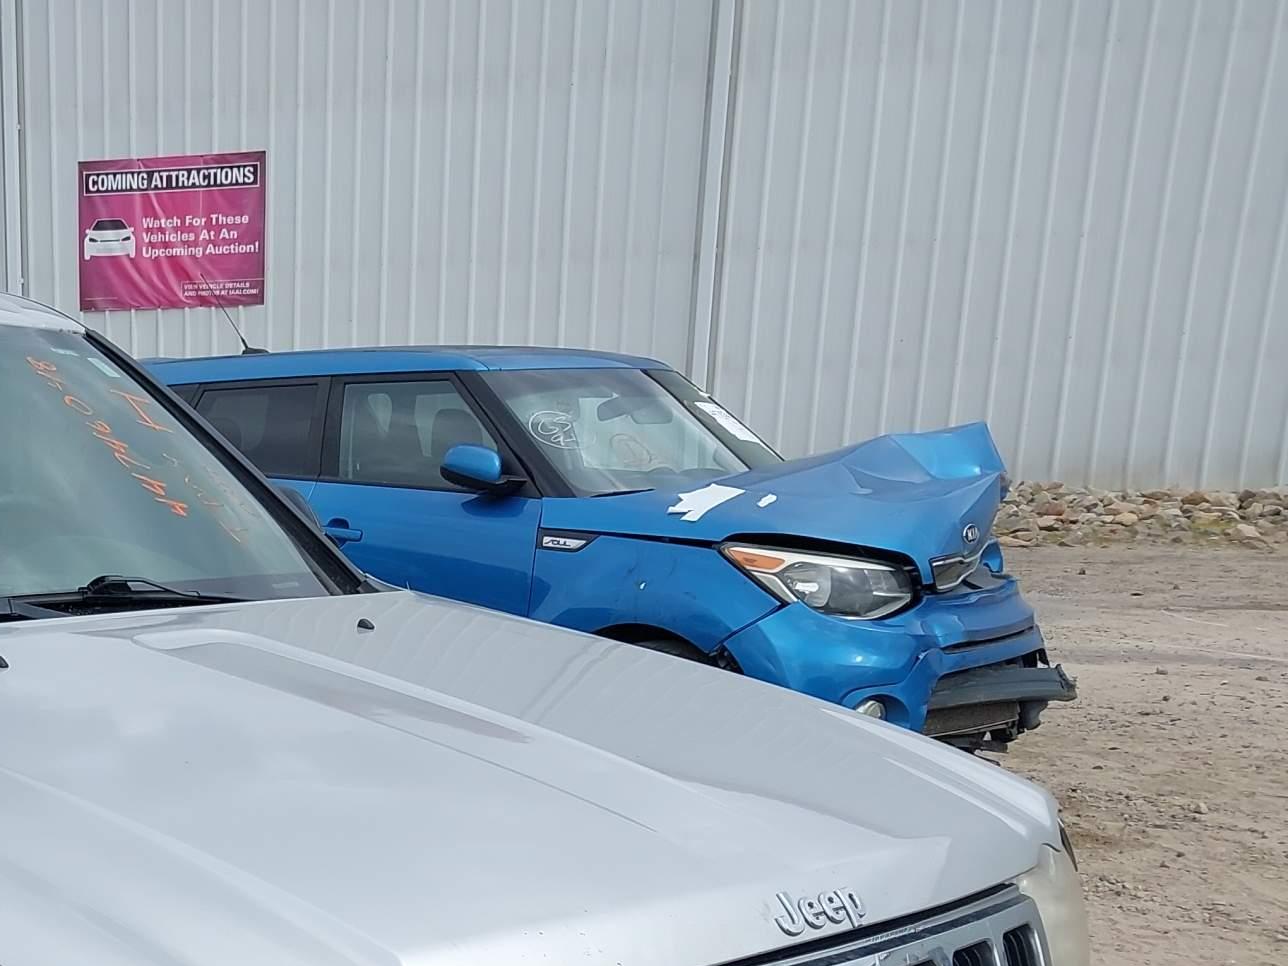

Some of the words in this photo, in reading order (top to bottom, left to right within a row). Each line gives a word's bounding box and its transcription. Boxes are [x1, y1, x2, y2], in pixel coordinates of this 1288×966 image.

[88, 173, 148, 192] COMING
[150, 166, 255, 189] ATTRACTIONS
[142, 216, 181, 229] Watch
[185, 215, 207, 226] For
[210, 214, 249, 225] These
[142, 230, 195, 243] Vehicles
[199, 229, 215, 241] At
[219, 228, 238, 239] An
[142, 245, 203, 259] Upcoming
[205, 240, 260, 255] Auction!
[774, 886, 866, 937] Jeep
